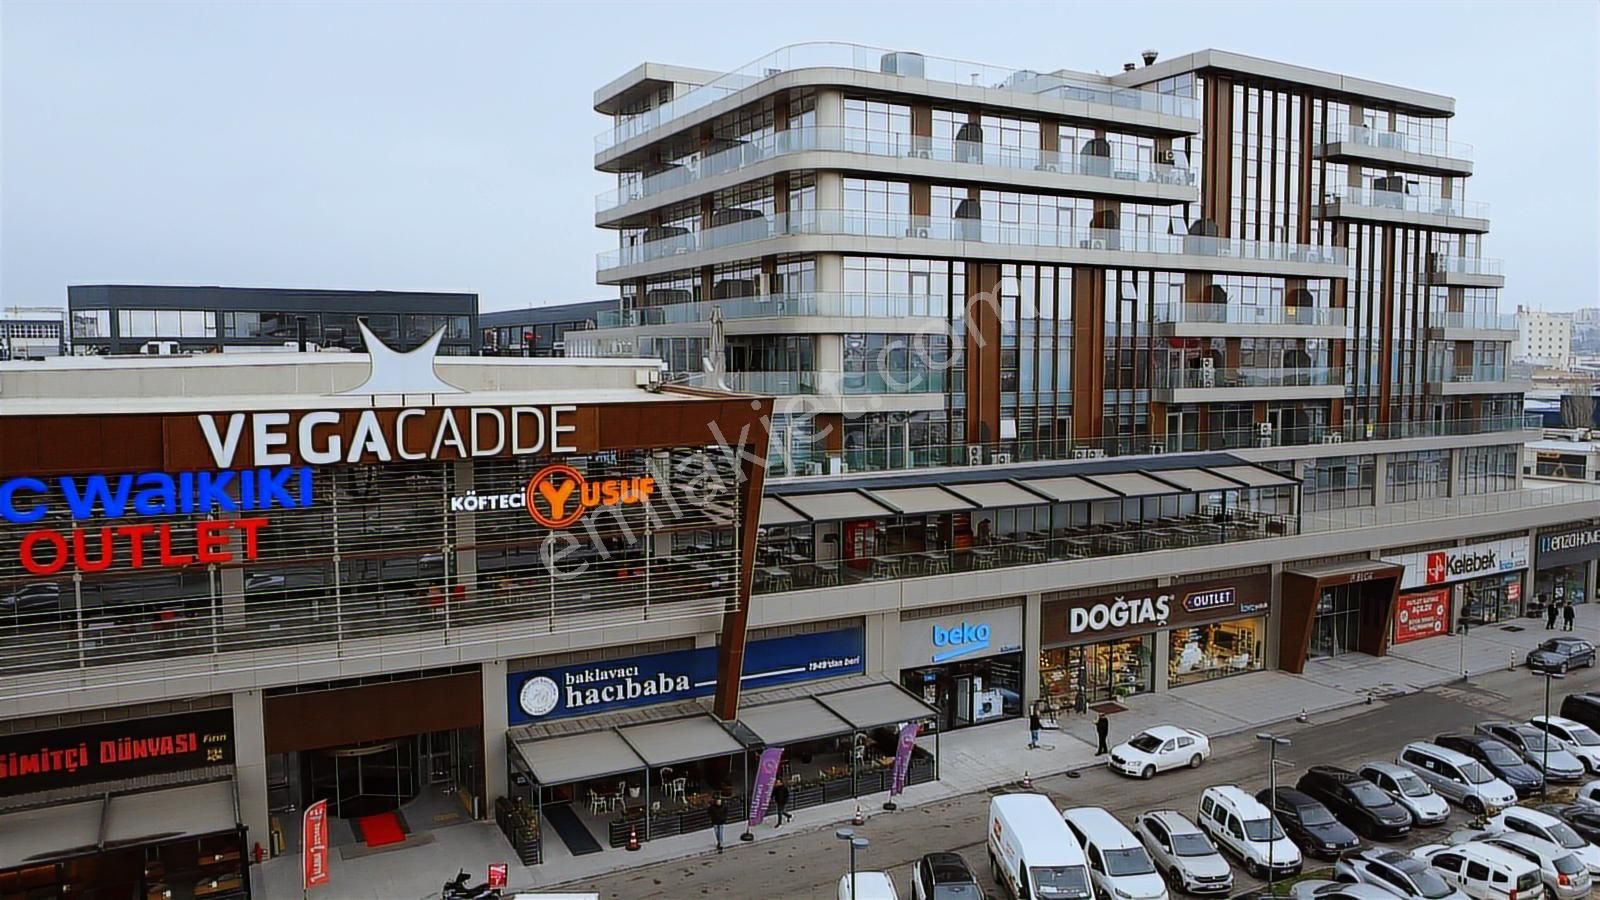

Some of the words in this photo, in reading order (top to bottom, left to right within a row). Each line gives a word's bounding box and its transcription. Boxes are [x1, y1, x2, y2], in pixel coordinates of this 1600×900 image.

[451, 486, 526, 512] KÖFTECİ
[19, 518, 269, 576] OUTLET
[1445, 549, 1497, 576] Kelebek
[1194, 591, 1231, 608] OUTLET
[1070, 594, 1171, 633] DOĞTAŞ
[932, 622, 992, 647] beko
[565, 666, 639, 686] baklavacı
[565, 672, 691, 709] hacıbaba
[100, 732, 199, 764] DÜNYASI
